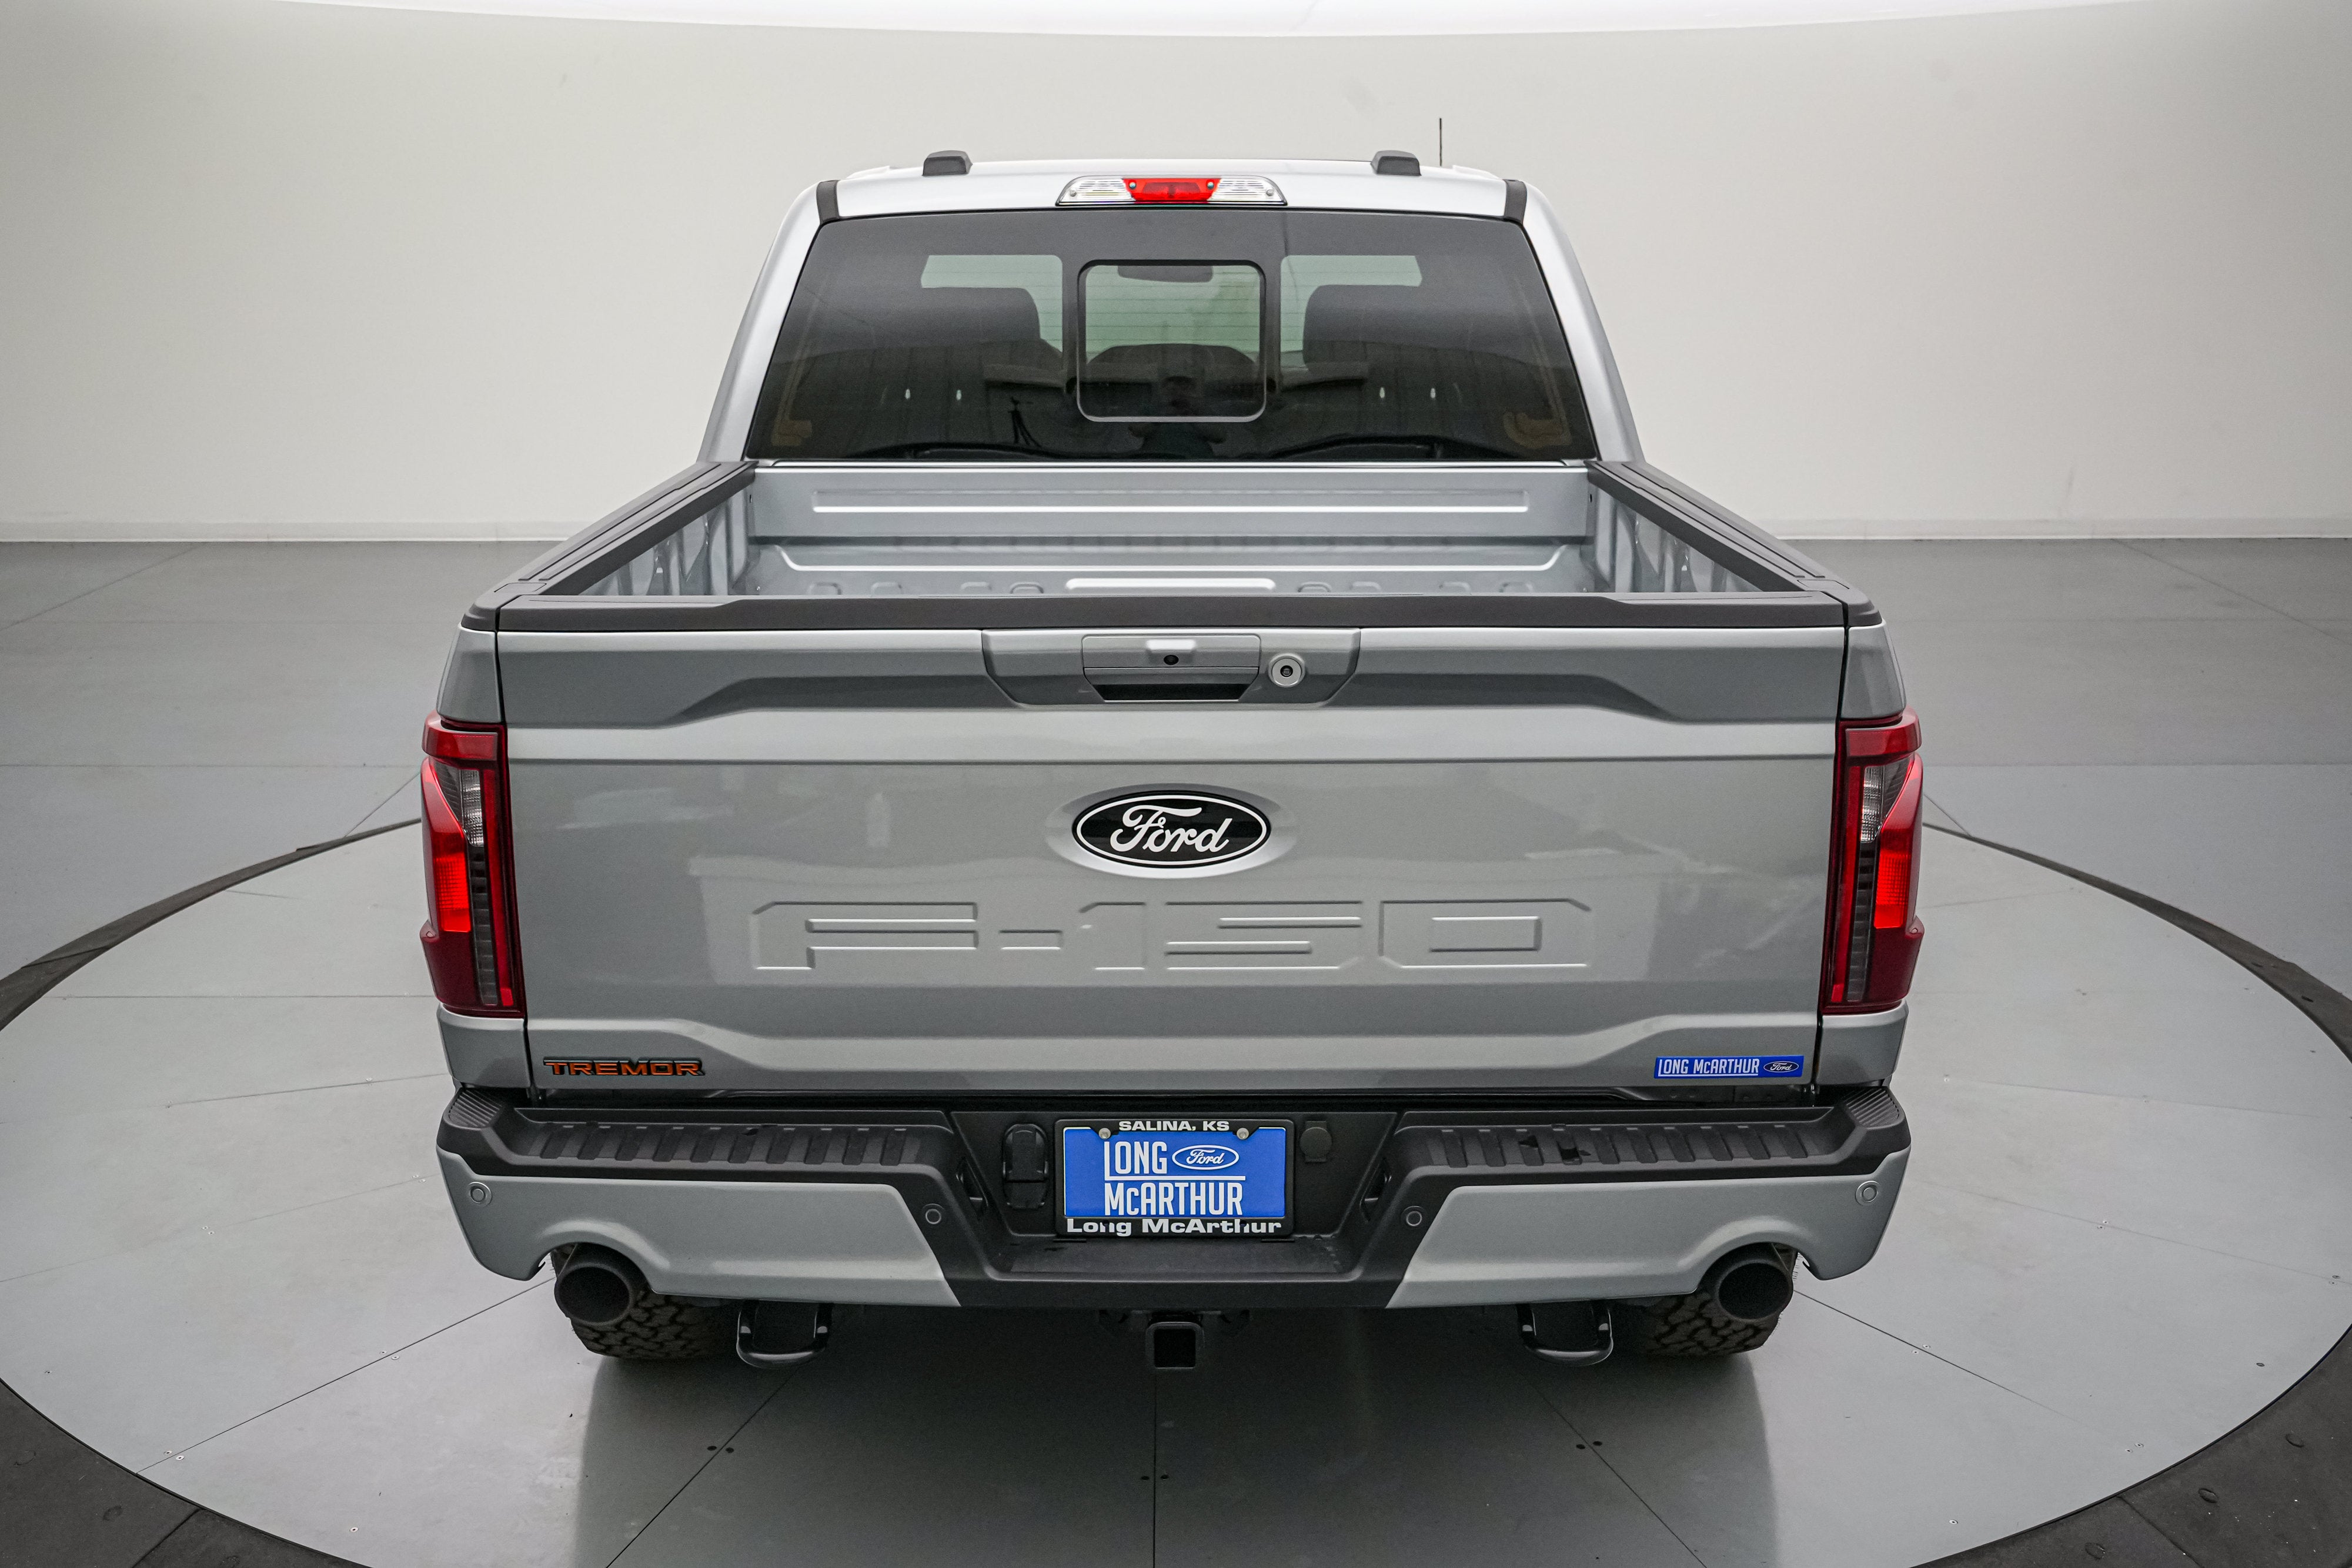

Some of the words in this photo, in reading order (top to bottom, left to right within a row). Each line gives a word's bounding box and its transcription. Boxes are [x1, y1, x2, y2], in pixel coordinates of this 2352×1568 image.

[1110, 804, 1233, 852] Ford
[750, 900, 1592, 970] F-150
[543, 1059, 704, 1075] TREMOR
[1658, 1059, 1688, 1076] LONG
[1693, 1058, 1760, 1074] McARTHUR
[1769, 1062, 1792, 1071] Ford
[1118, 1121, 1196, 1131] SALINA,
[1202, 1121, 1230, 1131] KS
[1104, 1141, 1167, 1179] LONG
[1185, 1149, 1225, 1165] Ford
[1104, 1182, 1243, 1216] McARTHUR
[1067, 1218, 1131, 1237] Long
[1142, 1218, 1282, 1233] McArthur
